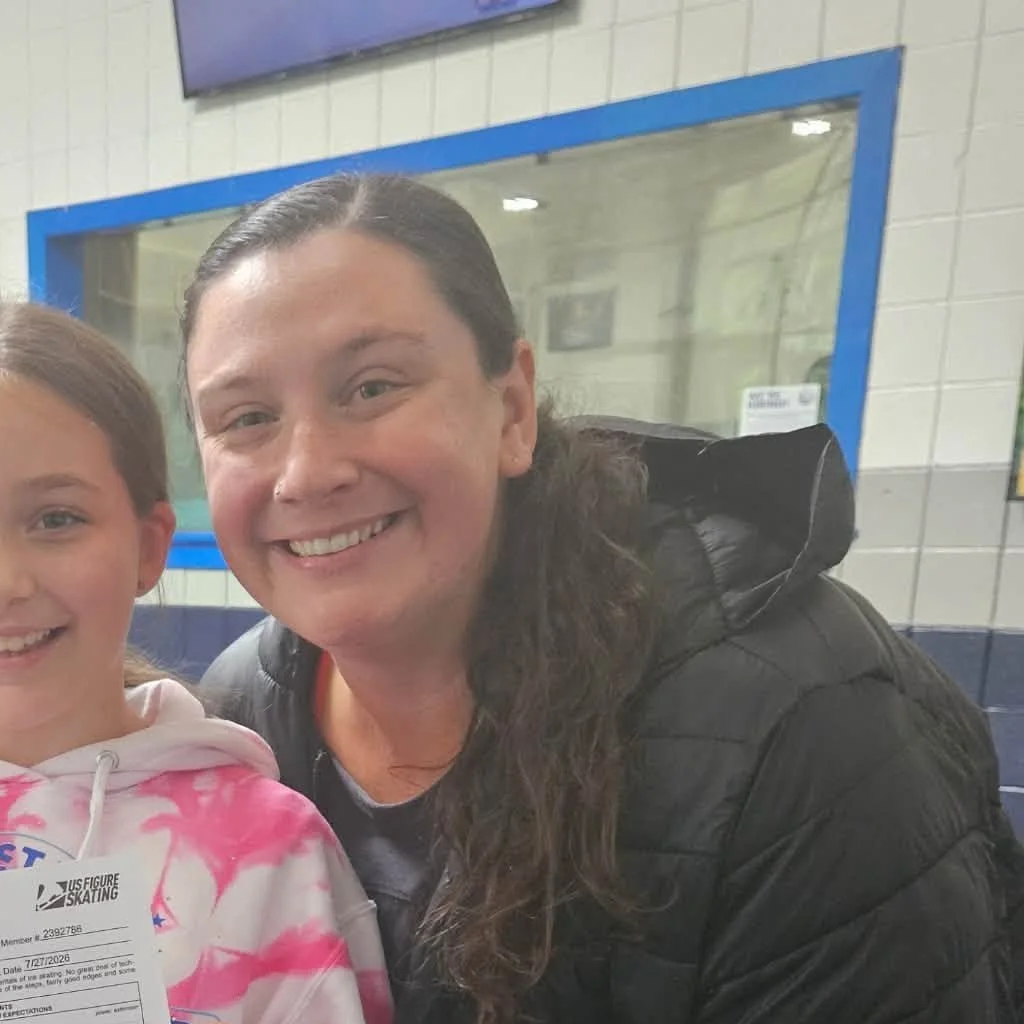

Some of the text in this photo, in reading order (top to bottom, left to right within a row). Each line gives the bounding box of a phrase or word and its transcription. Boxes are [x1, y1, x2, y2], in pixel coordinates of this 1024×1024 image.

[68, 873, 120, 892] US FIGURE
[66, 886, 119, 907] SKATING
[0, 935, 32, 947] Member
[3, 953, 70, 974] Date 7/27/2026
[12, 982, 23, 990] the
[64, 974, 80, 984] good
[104, 968, 116, 976] and
[2, 1005, 52, 1017] EXPECTATIONS
